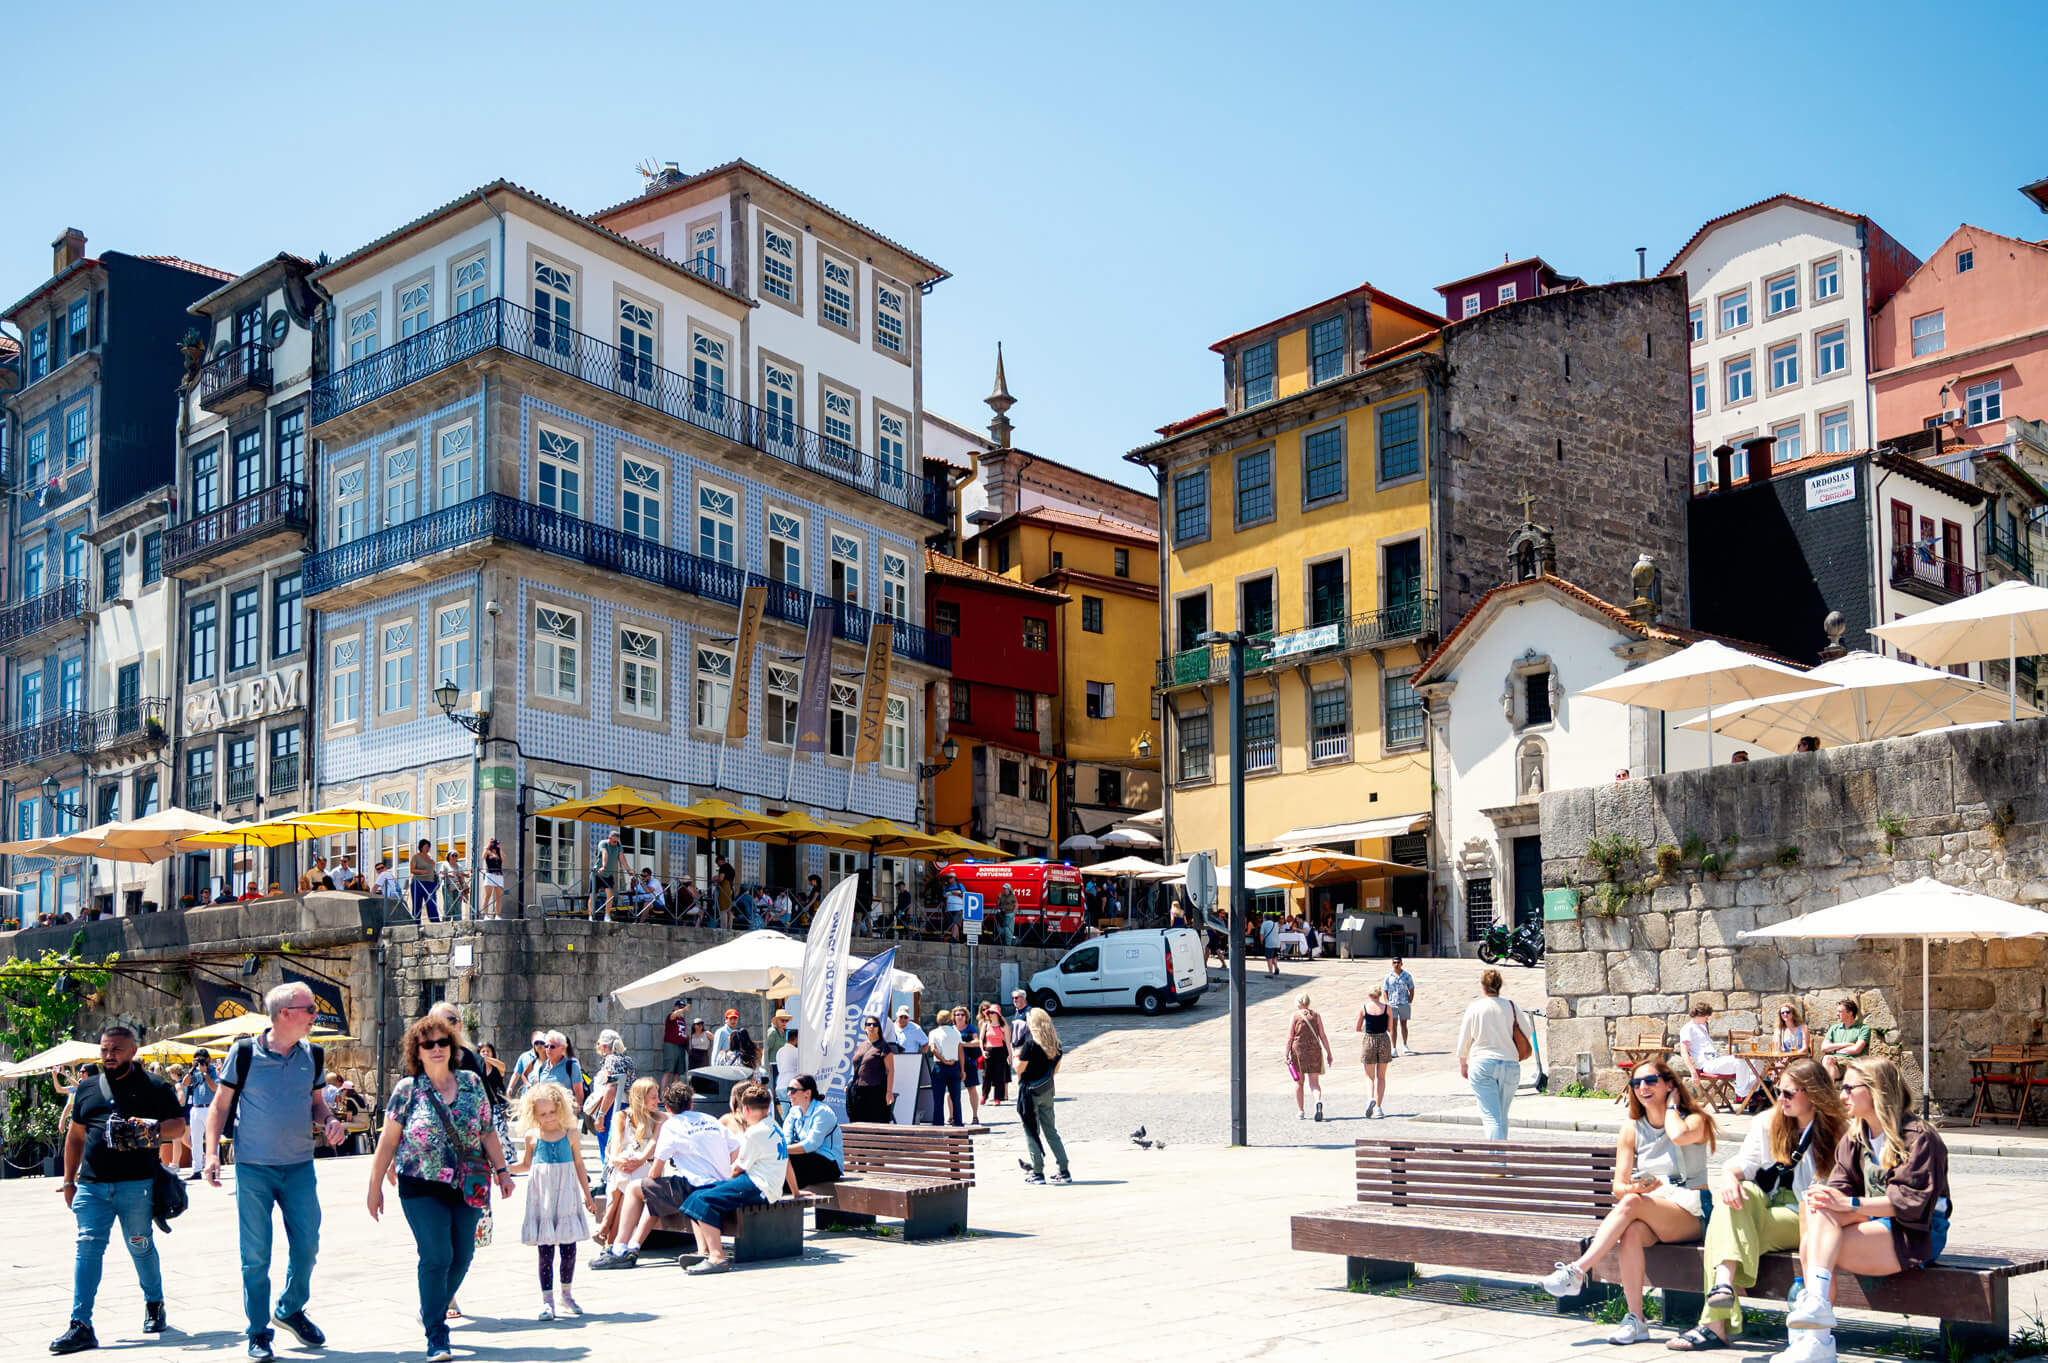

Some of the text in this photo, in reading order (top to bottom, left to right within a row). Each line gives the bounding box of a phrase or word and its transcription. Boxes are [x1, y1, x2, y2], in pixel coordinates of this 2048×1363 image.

[1812, 472, 1850, 488] ARDOSIAS
[1016, 888, 1031, 896] 112
[968, 895, 979, 917] P
[826, 959, 835, 979] DO
[824, 982, 834, 1029] TOMAZ
[830, 1004, 862, 1089] DOURO
